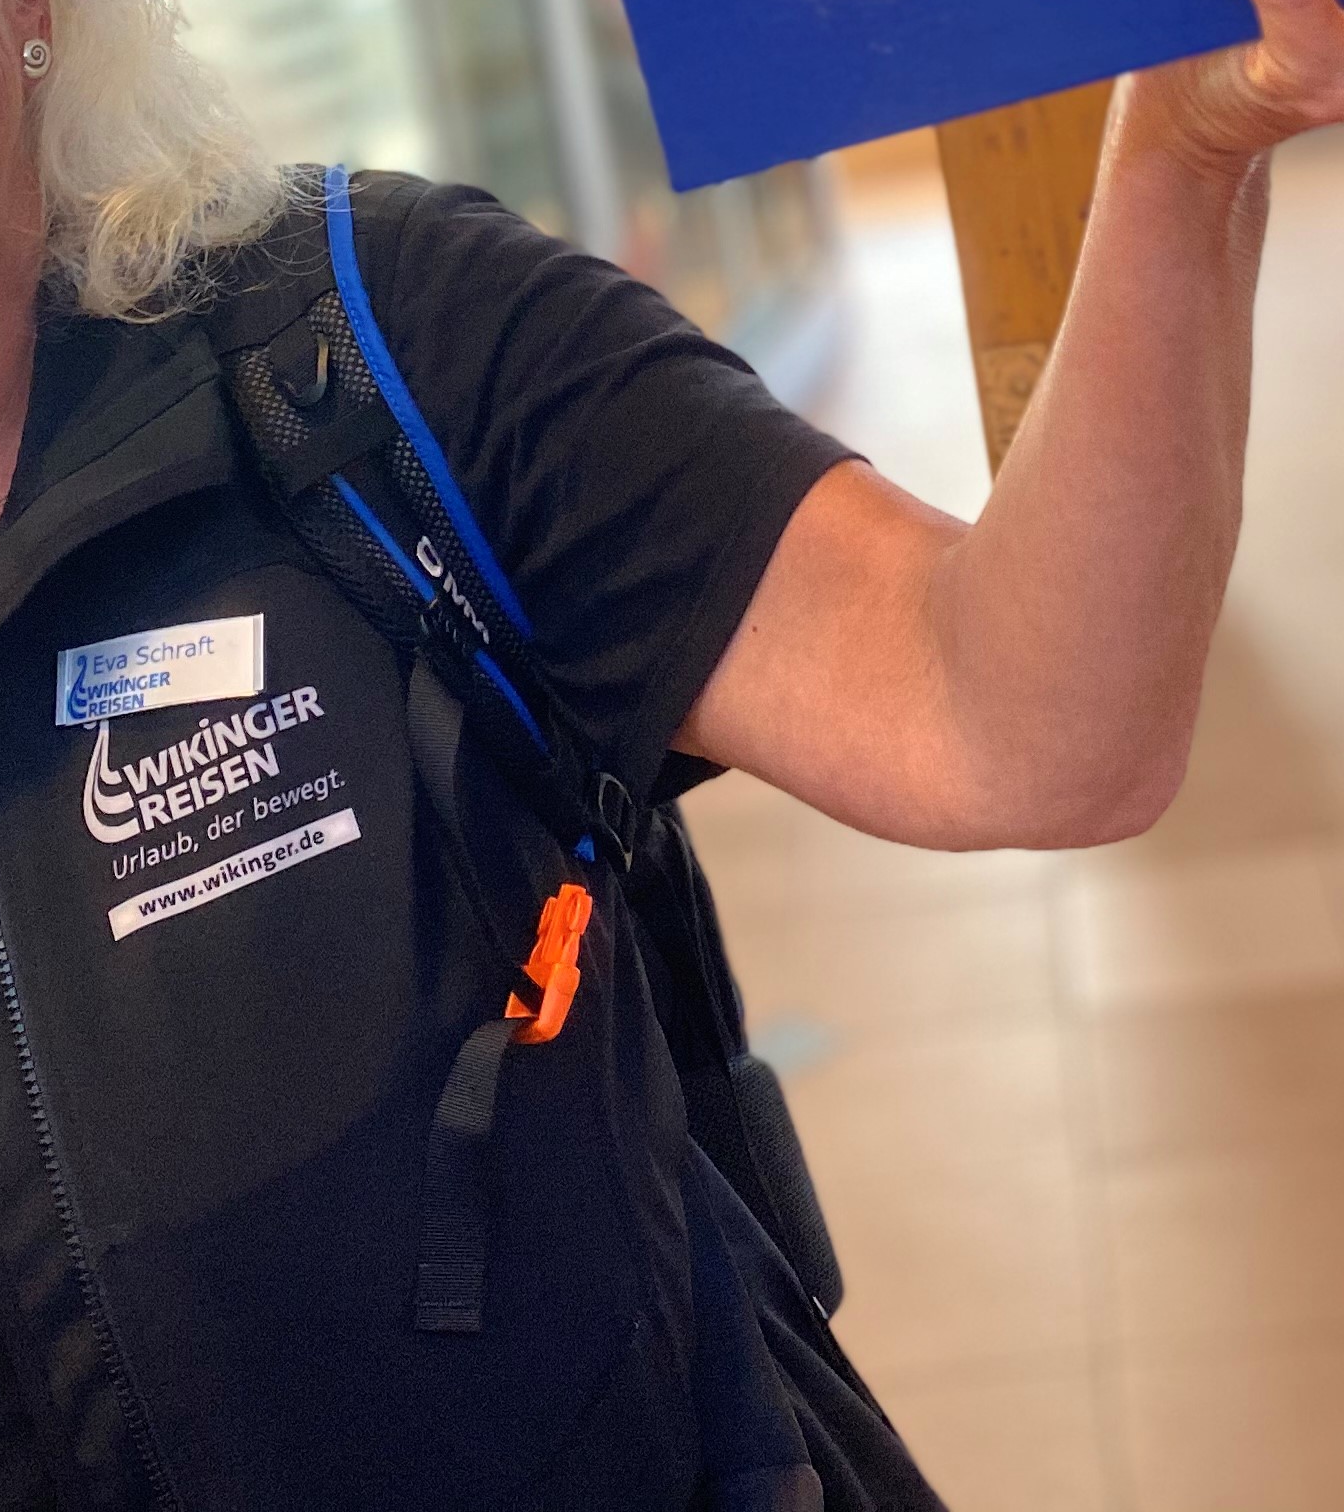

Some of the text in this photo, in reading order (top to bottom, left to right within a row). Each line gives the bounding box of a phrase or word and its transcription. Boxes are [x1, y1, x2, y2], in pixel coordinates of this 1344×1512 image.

[93, 636, 215, 675] Eva Schraft
[88, 694, 145, 718] REISEN
[112, 768, 346, 881] Urlaub, der bewegt.
[138, 743, 280, 831] REISEN
[138, 827, 325, 918] www.wikinger.de
